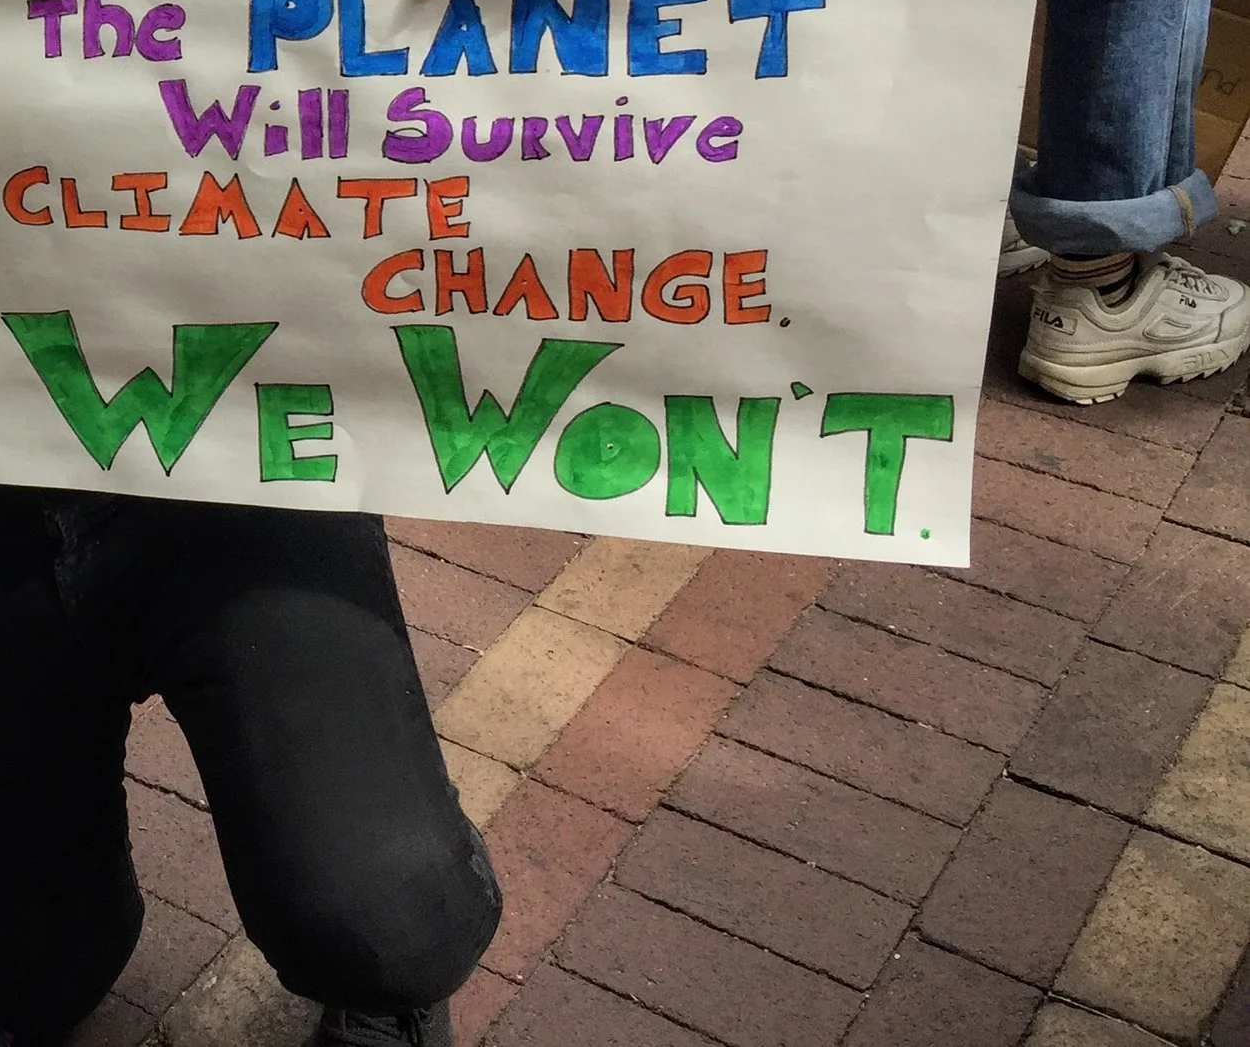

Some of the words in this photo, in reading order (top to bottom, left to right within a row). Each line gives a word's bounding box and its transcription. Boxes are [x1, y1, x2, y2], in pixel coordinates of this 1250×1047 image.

[158, 78, 350, 161] Will
[2, 165, 470, 240] CLIMATE
[361, 247, 791, 328] CHANGE.
[1033, 307, 1064, 329] FILA
[1179, 295, 1197, 309] FILA
[0, 309, 339, 477] WE
